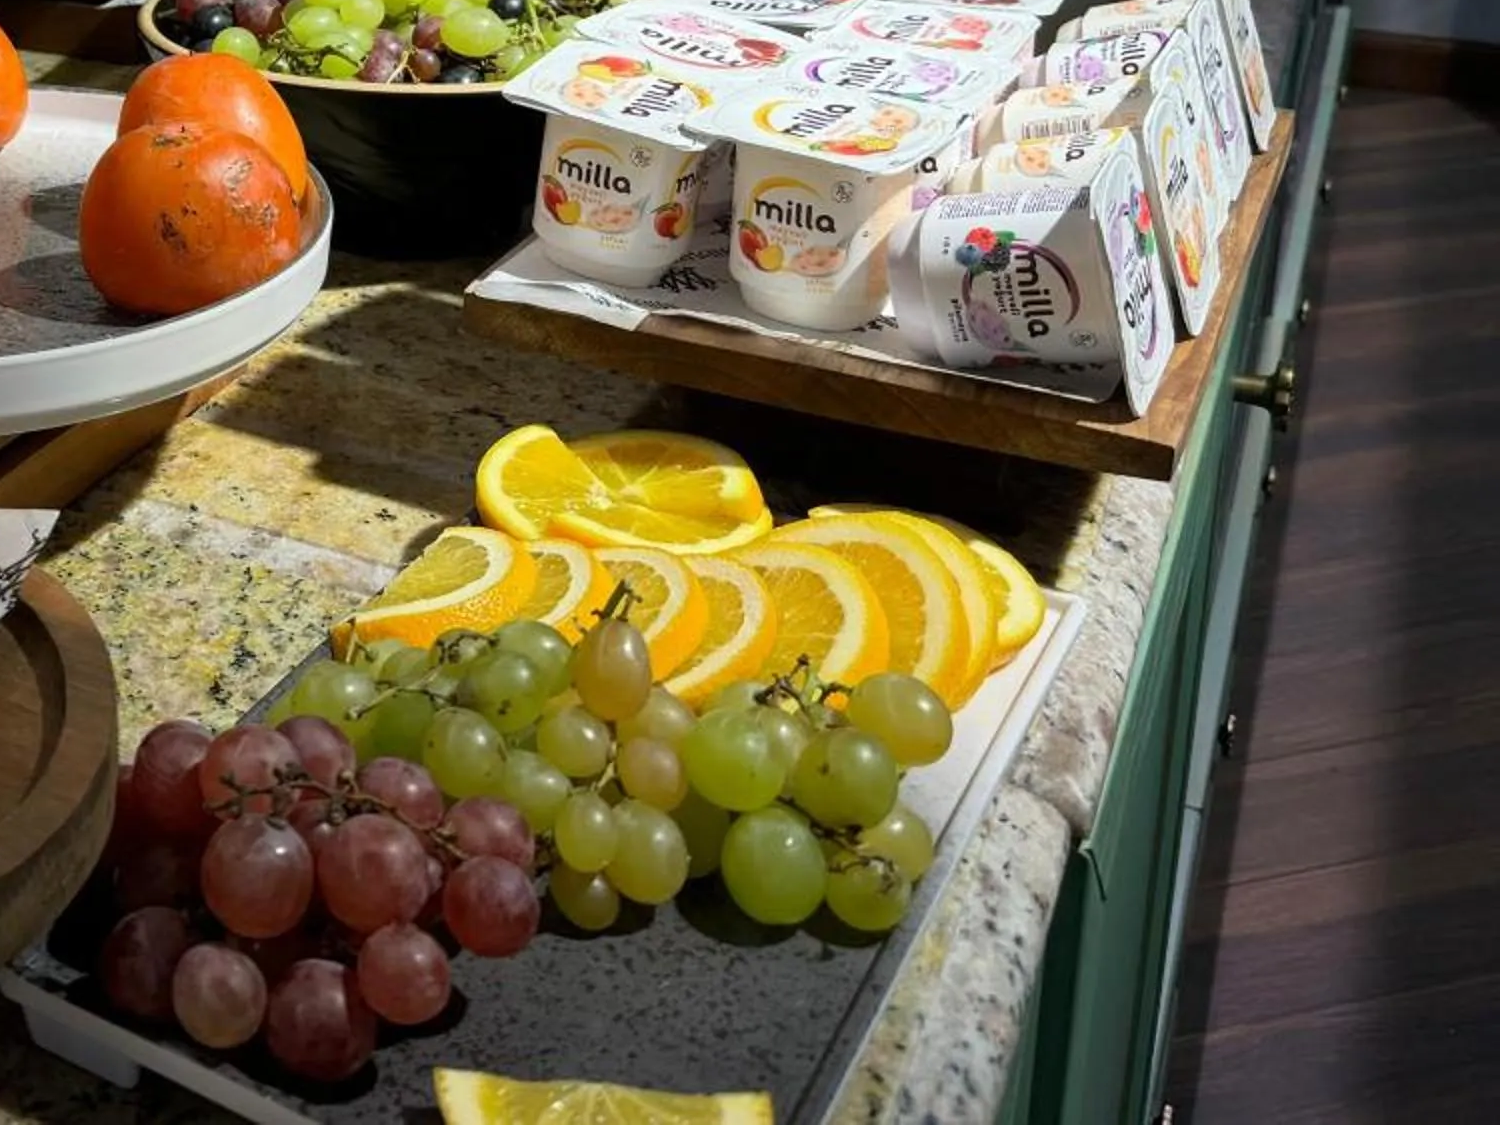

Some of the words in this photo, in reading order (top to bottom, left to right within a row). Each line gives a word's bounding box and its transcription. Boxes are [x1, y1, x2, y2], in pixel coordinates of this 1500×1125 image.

[641, 26, 742, 67] milla
[836, 55, 897, 88] milla
[620, 78, 684, 119] milla
[781, 103, 857, 138] milla
[557, 156, 631, 195] milla
[754, 197, 836, 233] milla
[1014, 252, 1055, 338] milla
